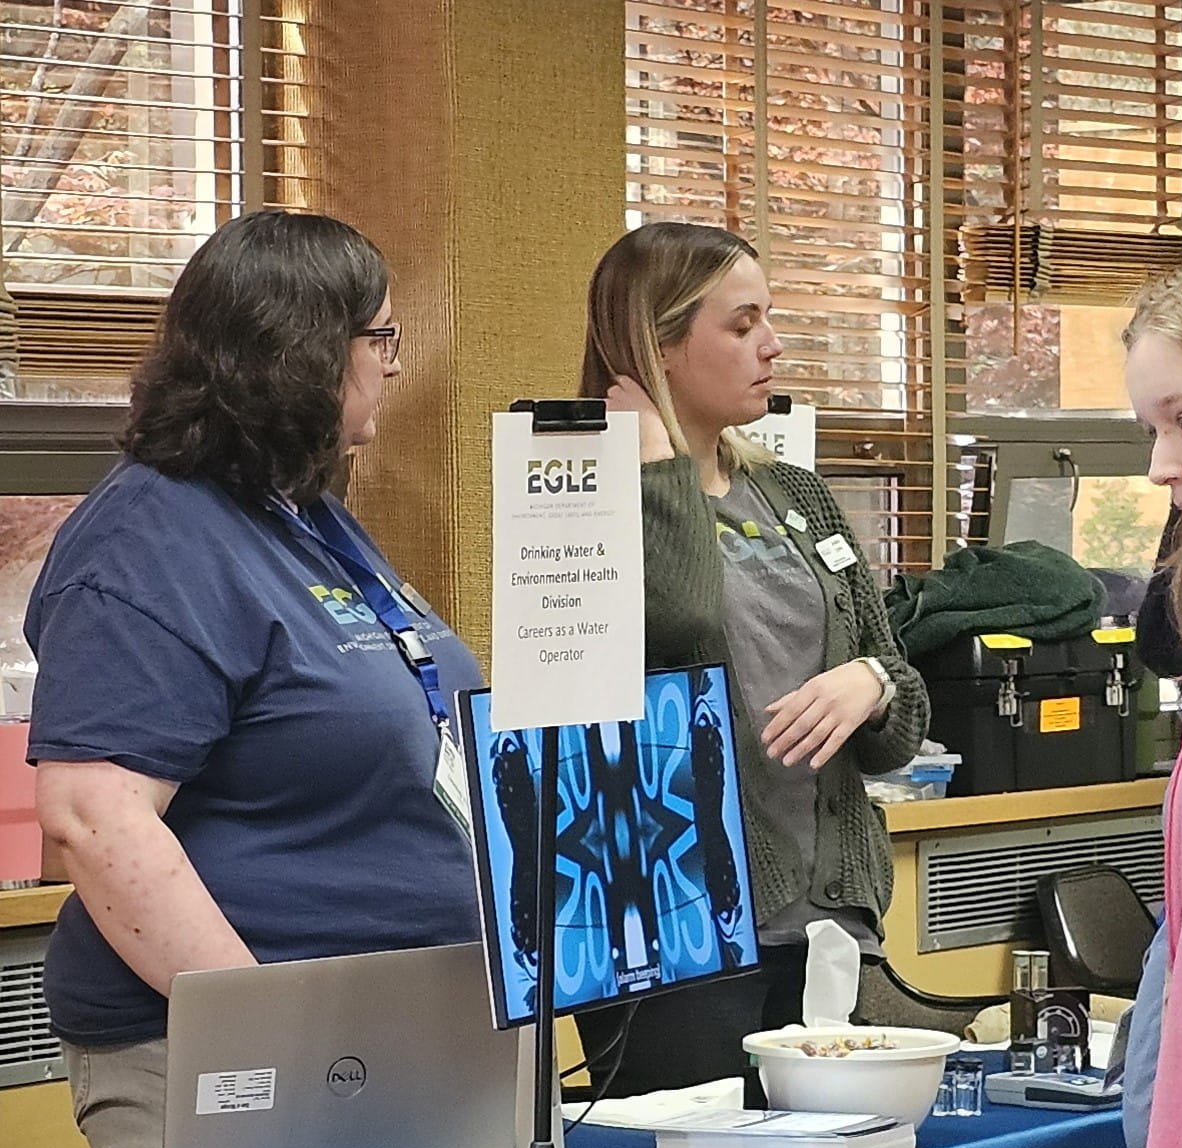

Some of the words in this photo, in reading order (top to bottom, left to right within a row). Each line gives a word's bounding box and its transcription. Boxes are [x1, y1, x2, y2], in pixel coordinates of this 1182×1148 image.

[527, 459, 597, 494] EGLE
[520, 544, 561, 561] Drinking
[563, 544, 594, 558] Water
[596, 542, 605, 556] &
[511, 569, 580, 586] Environmental
[582, 566, 618, 582] Health
[541, 594, 582, 609] Division
[517, 624, 553, 639] Careers
[555, 625, 566, 637] as
[568, 625, 575, 636] a
[577, 621, 608, 635] Water
[539, 648, 584, 665] Operator
[332, 1070, 362, 1082] DELL
